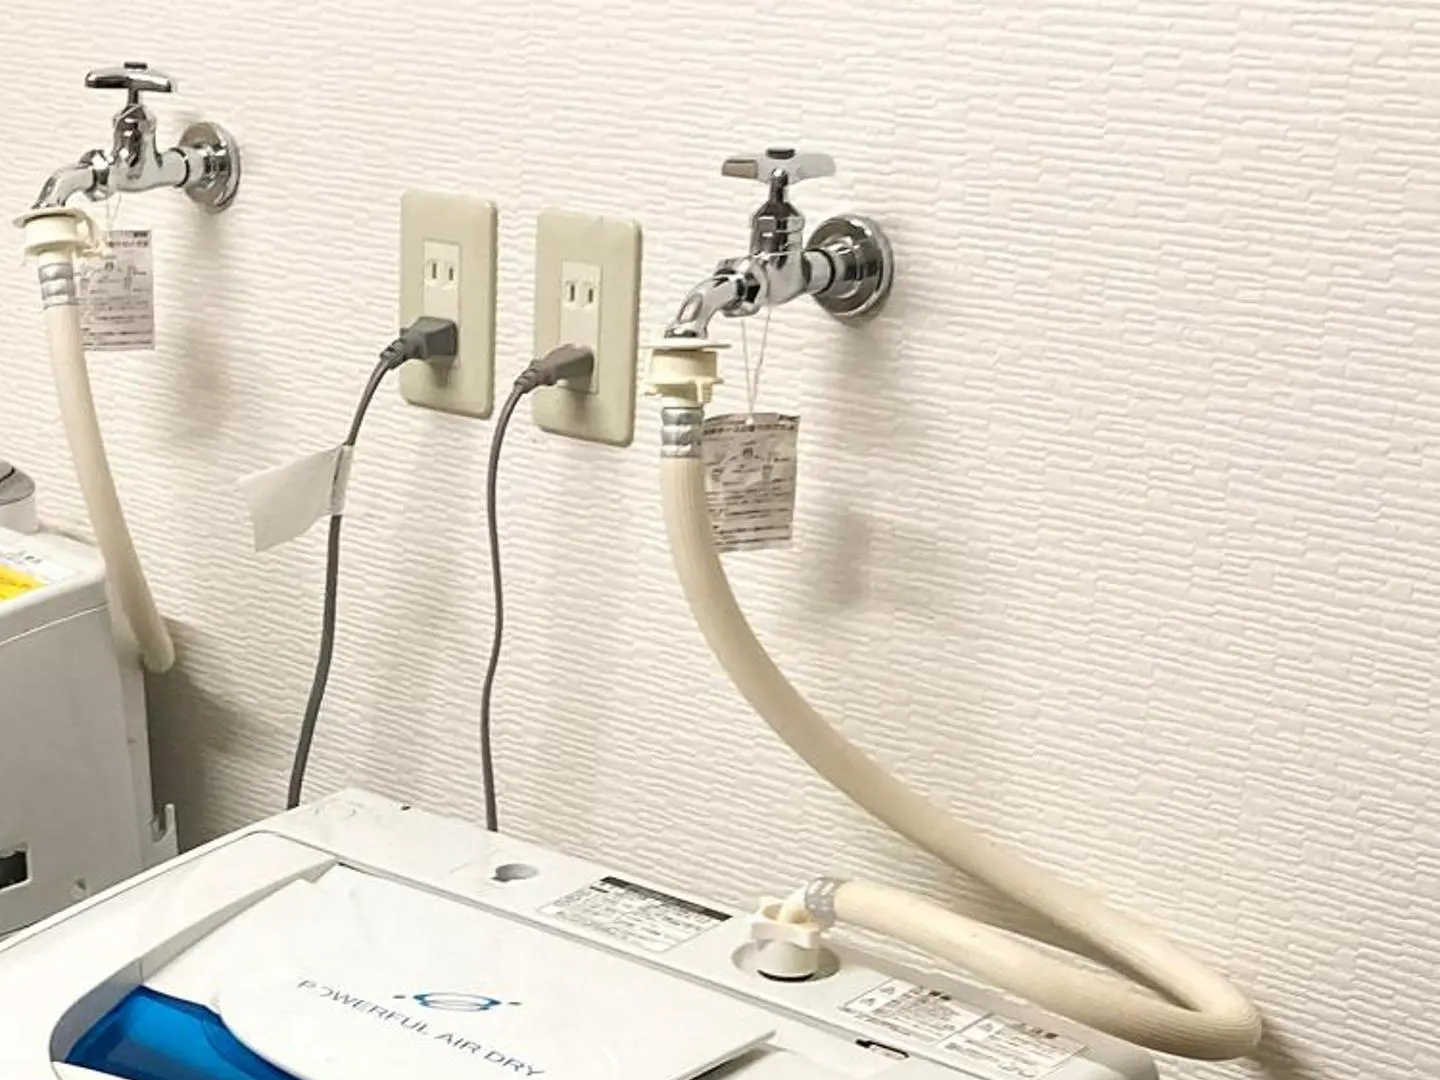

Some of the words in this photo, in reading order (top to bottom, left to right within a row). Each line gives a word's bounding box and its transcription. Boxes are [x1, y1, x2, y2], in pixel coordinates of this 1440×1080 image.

[297, 979, 430, 1035] POWERFUL
[434, 1032, 482, 1054] AIR
[484, 1049, 545, 1077] DRY
